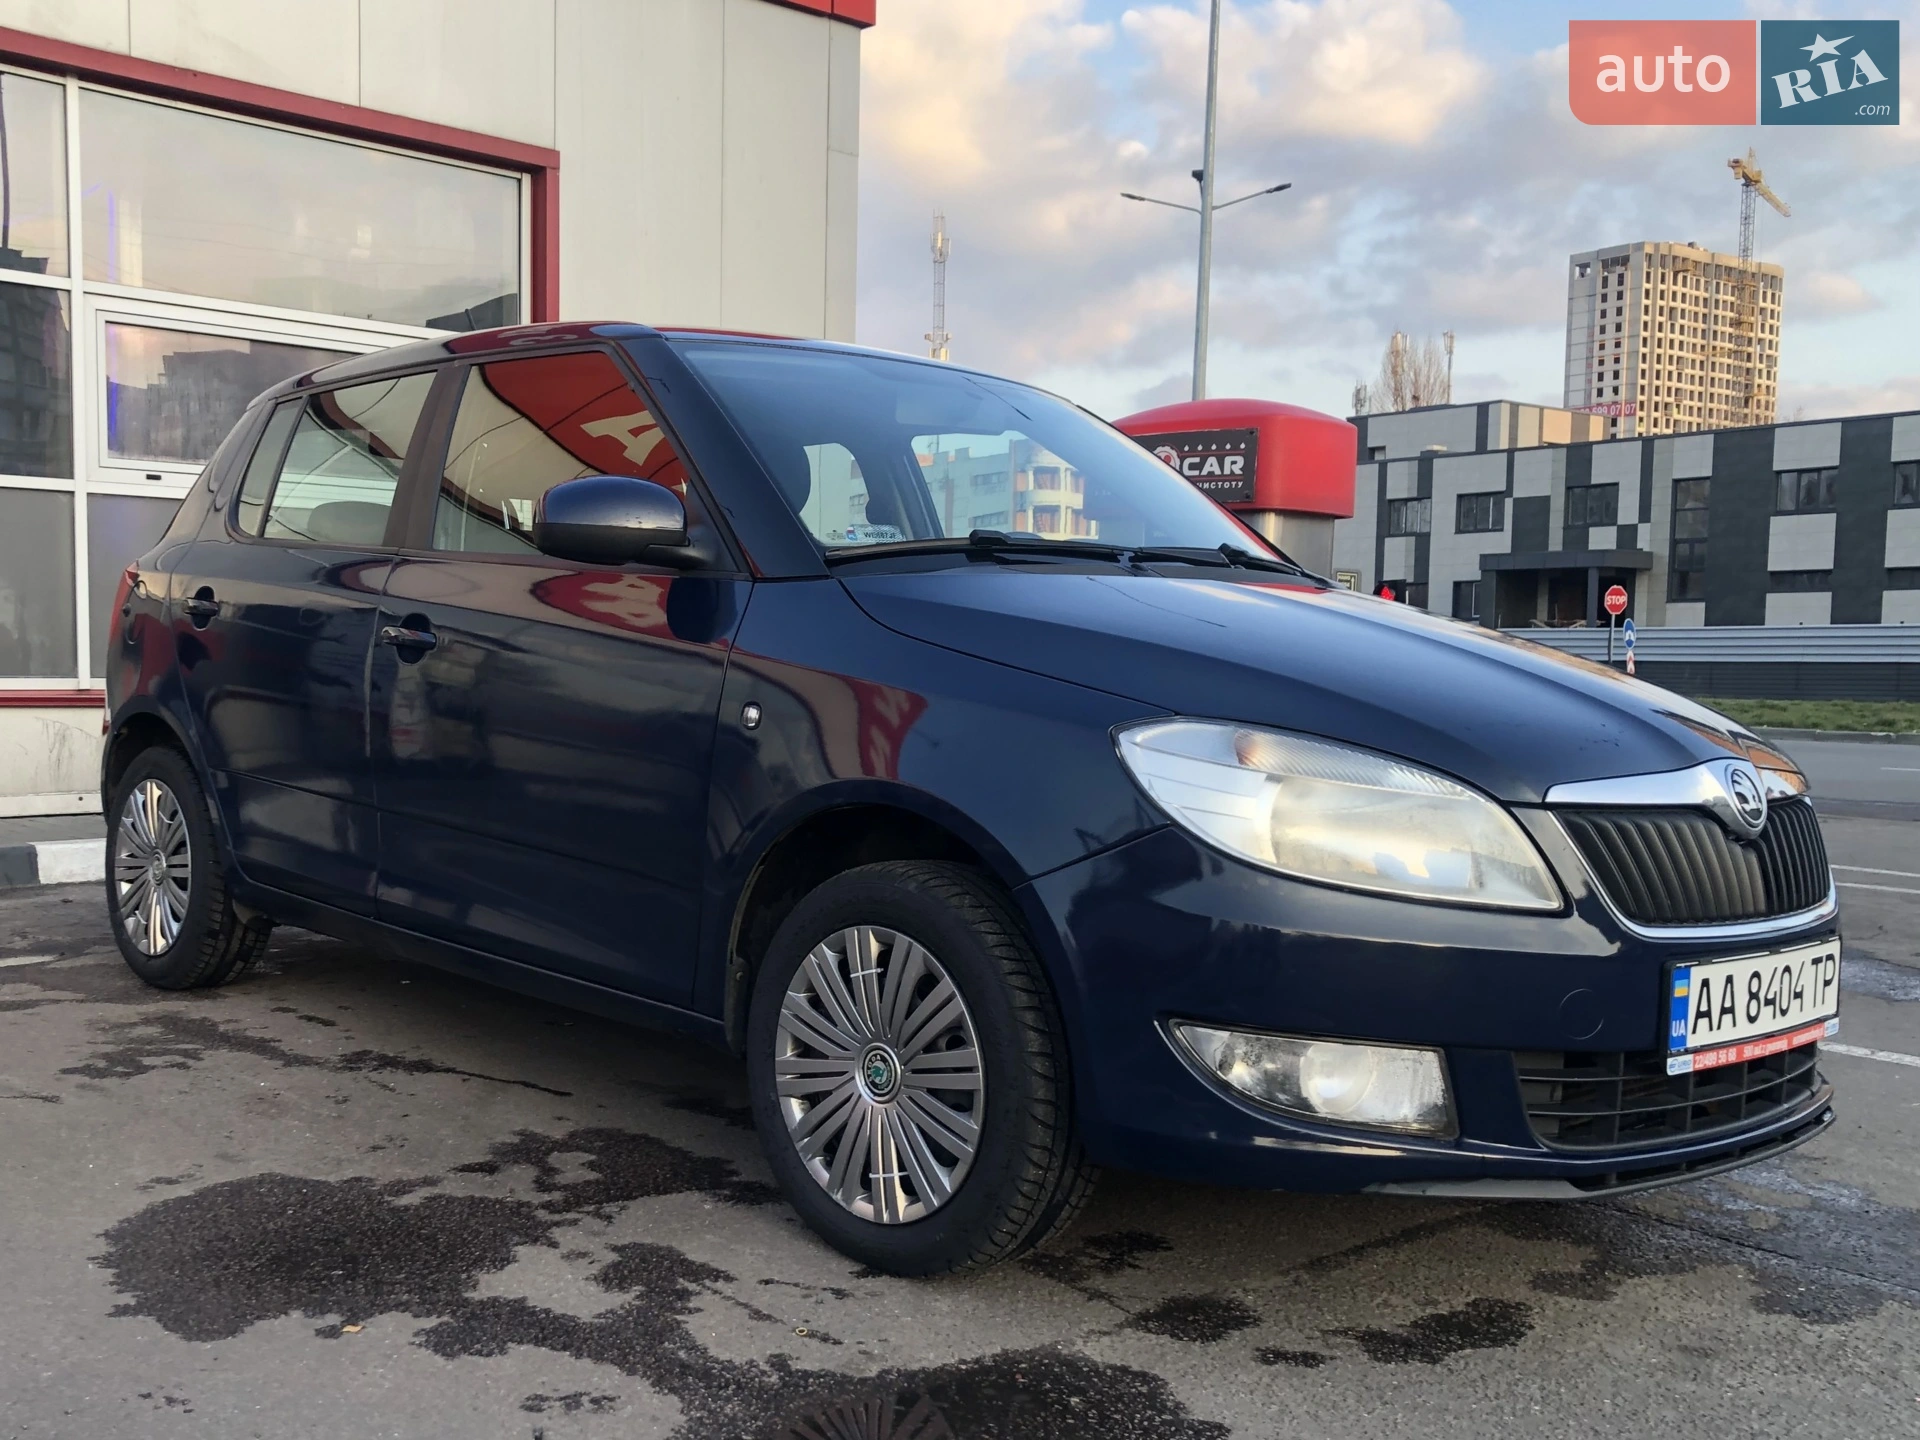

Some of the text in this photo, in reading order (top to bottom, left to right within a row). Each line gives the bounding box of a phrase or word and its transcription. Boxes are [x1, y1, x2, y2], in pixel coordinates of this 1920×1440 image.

[1610, 404, 1622, 416] 07
[1625, 403, 1636, 415] 07
[1607, 595, 1626, 605] STOP
[1691, 953, 1837, 1035] AA 8404 TP
[1671, 1018, 1686, 1037] UA
